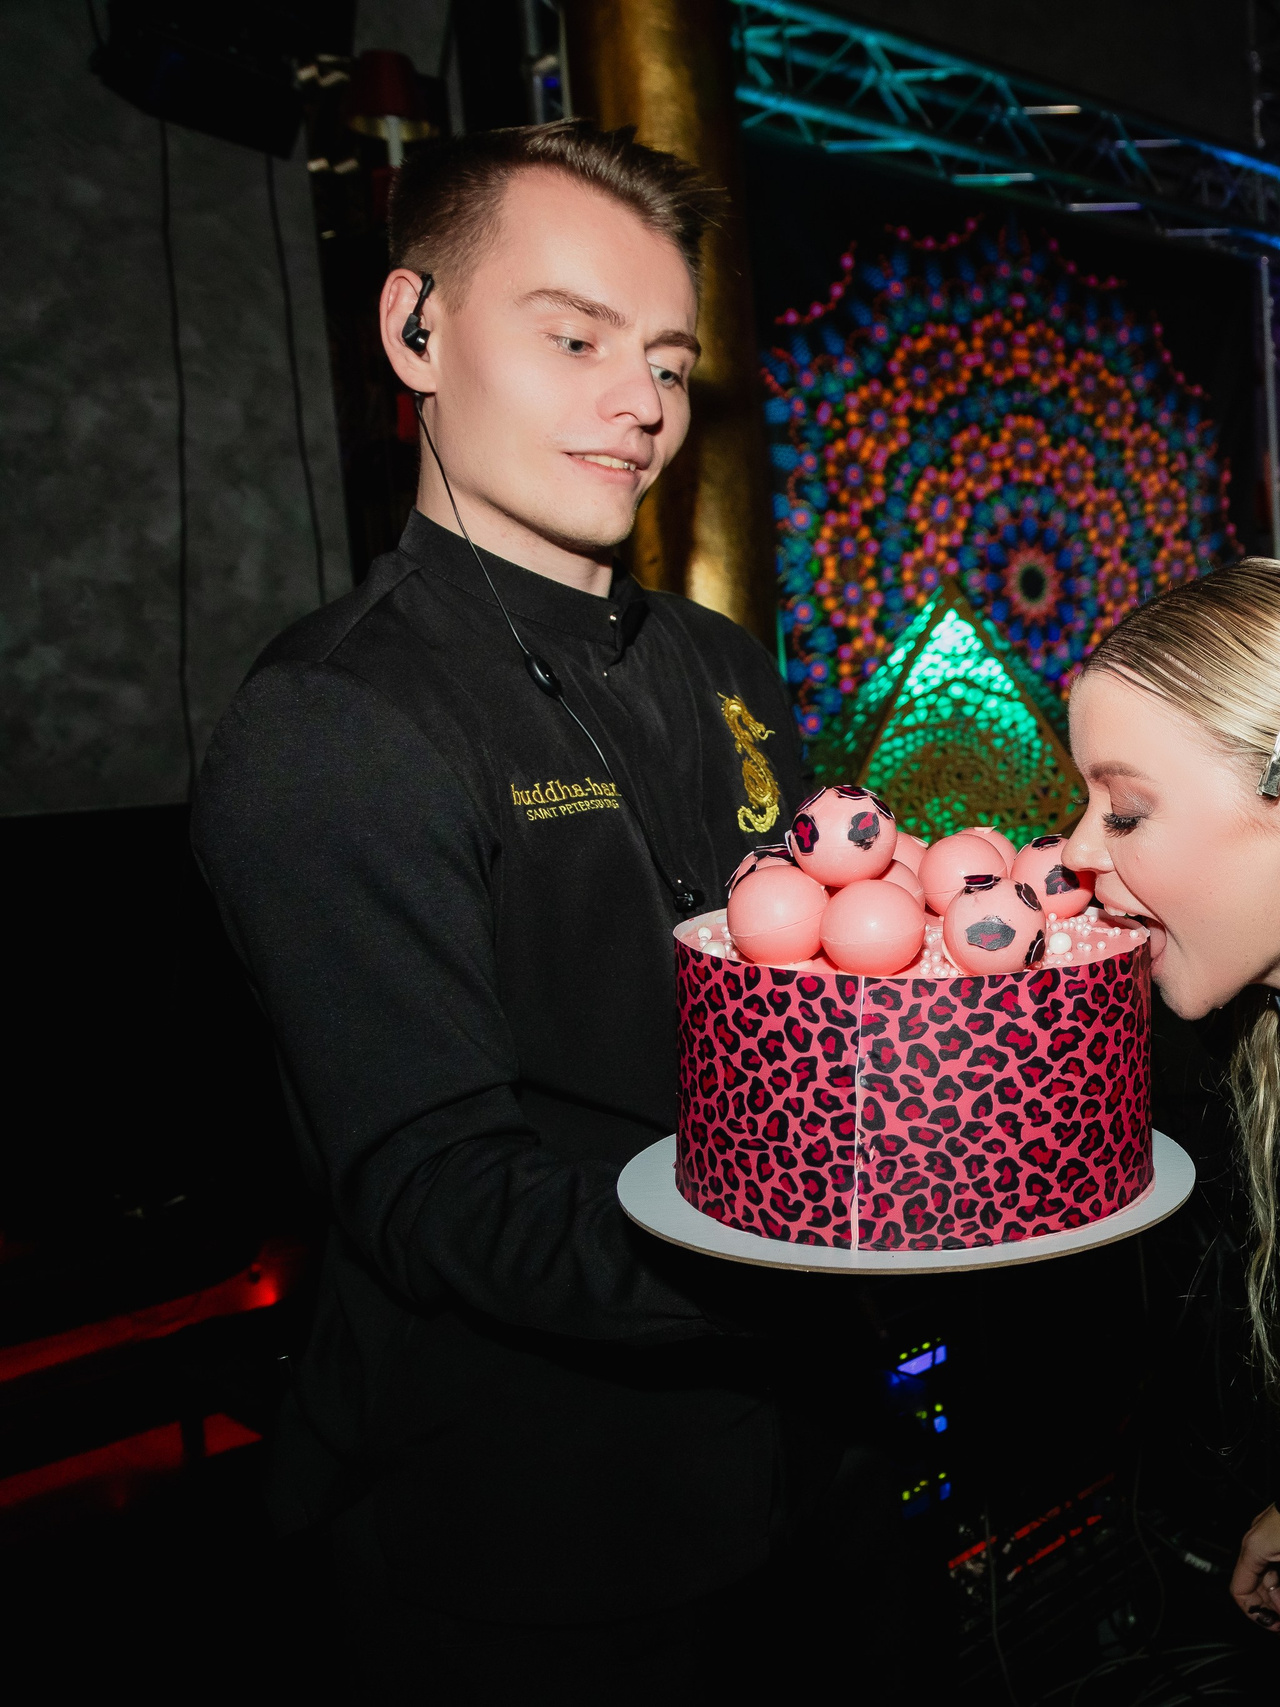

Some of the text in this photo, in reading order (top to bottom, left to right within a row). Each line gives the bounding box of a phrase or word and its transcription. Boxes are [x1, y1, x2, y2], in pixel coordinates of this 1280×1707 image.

[511, 777, 621, 805] buddha-bar
[526, 799, 619, 821] SAINT PETERSBURG
